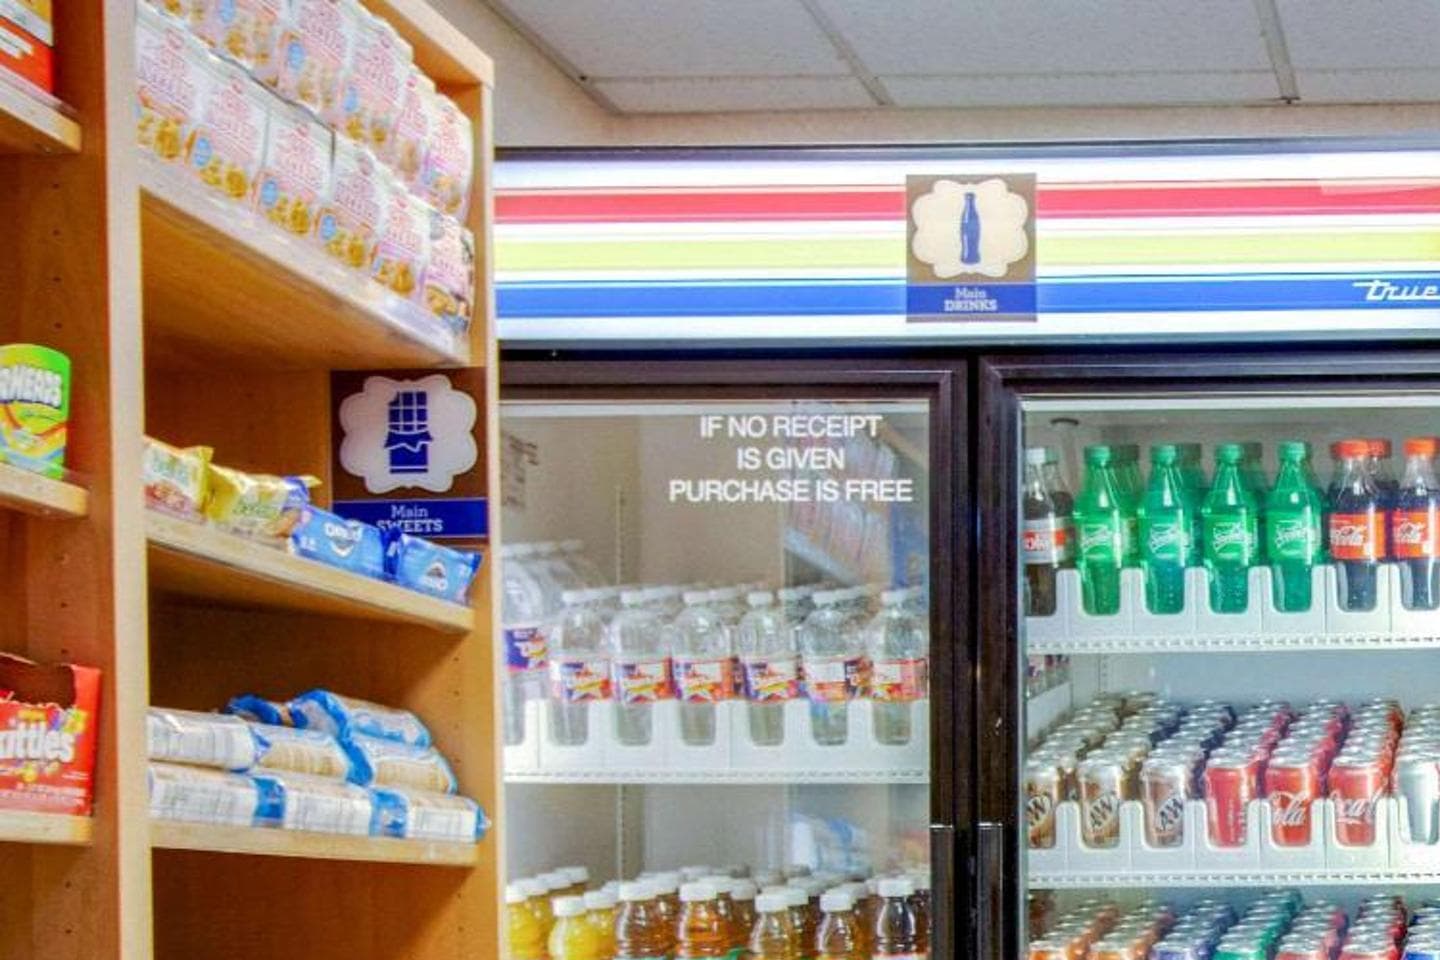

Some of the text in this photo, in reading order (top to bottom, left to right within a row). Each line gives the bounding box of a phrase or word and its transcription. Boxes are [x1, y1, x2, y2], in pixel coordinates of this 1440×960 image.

[955, 287, 986, 299] Main
[944, 300, 997, 311] DRINKS
[700, 415, 883, 438] IF NO RECEIPT
[737, 447, 845, 470] IS GIVEN
[669, 480, 913, 502] PURCHASE IS FREE
[391, 505, 428, 519] Main
[377, 519, 443, 533] SWEETS
